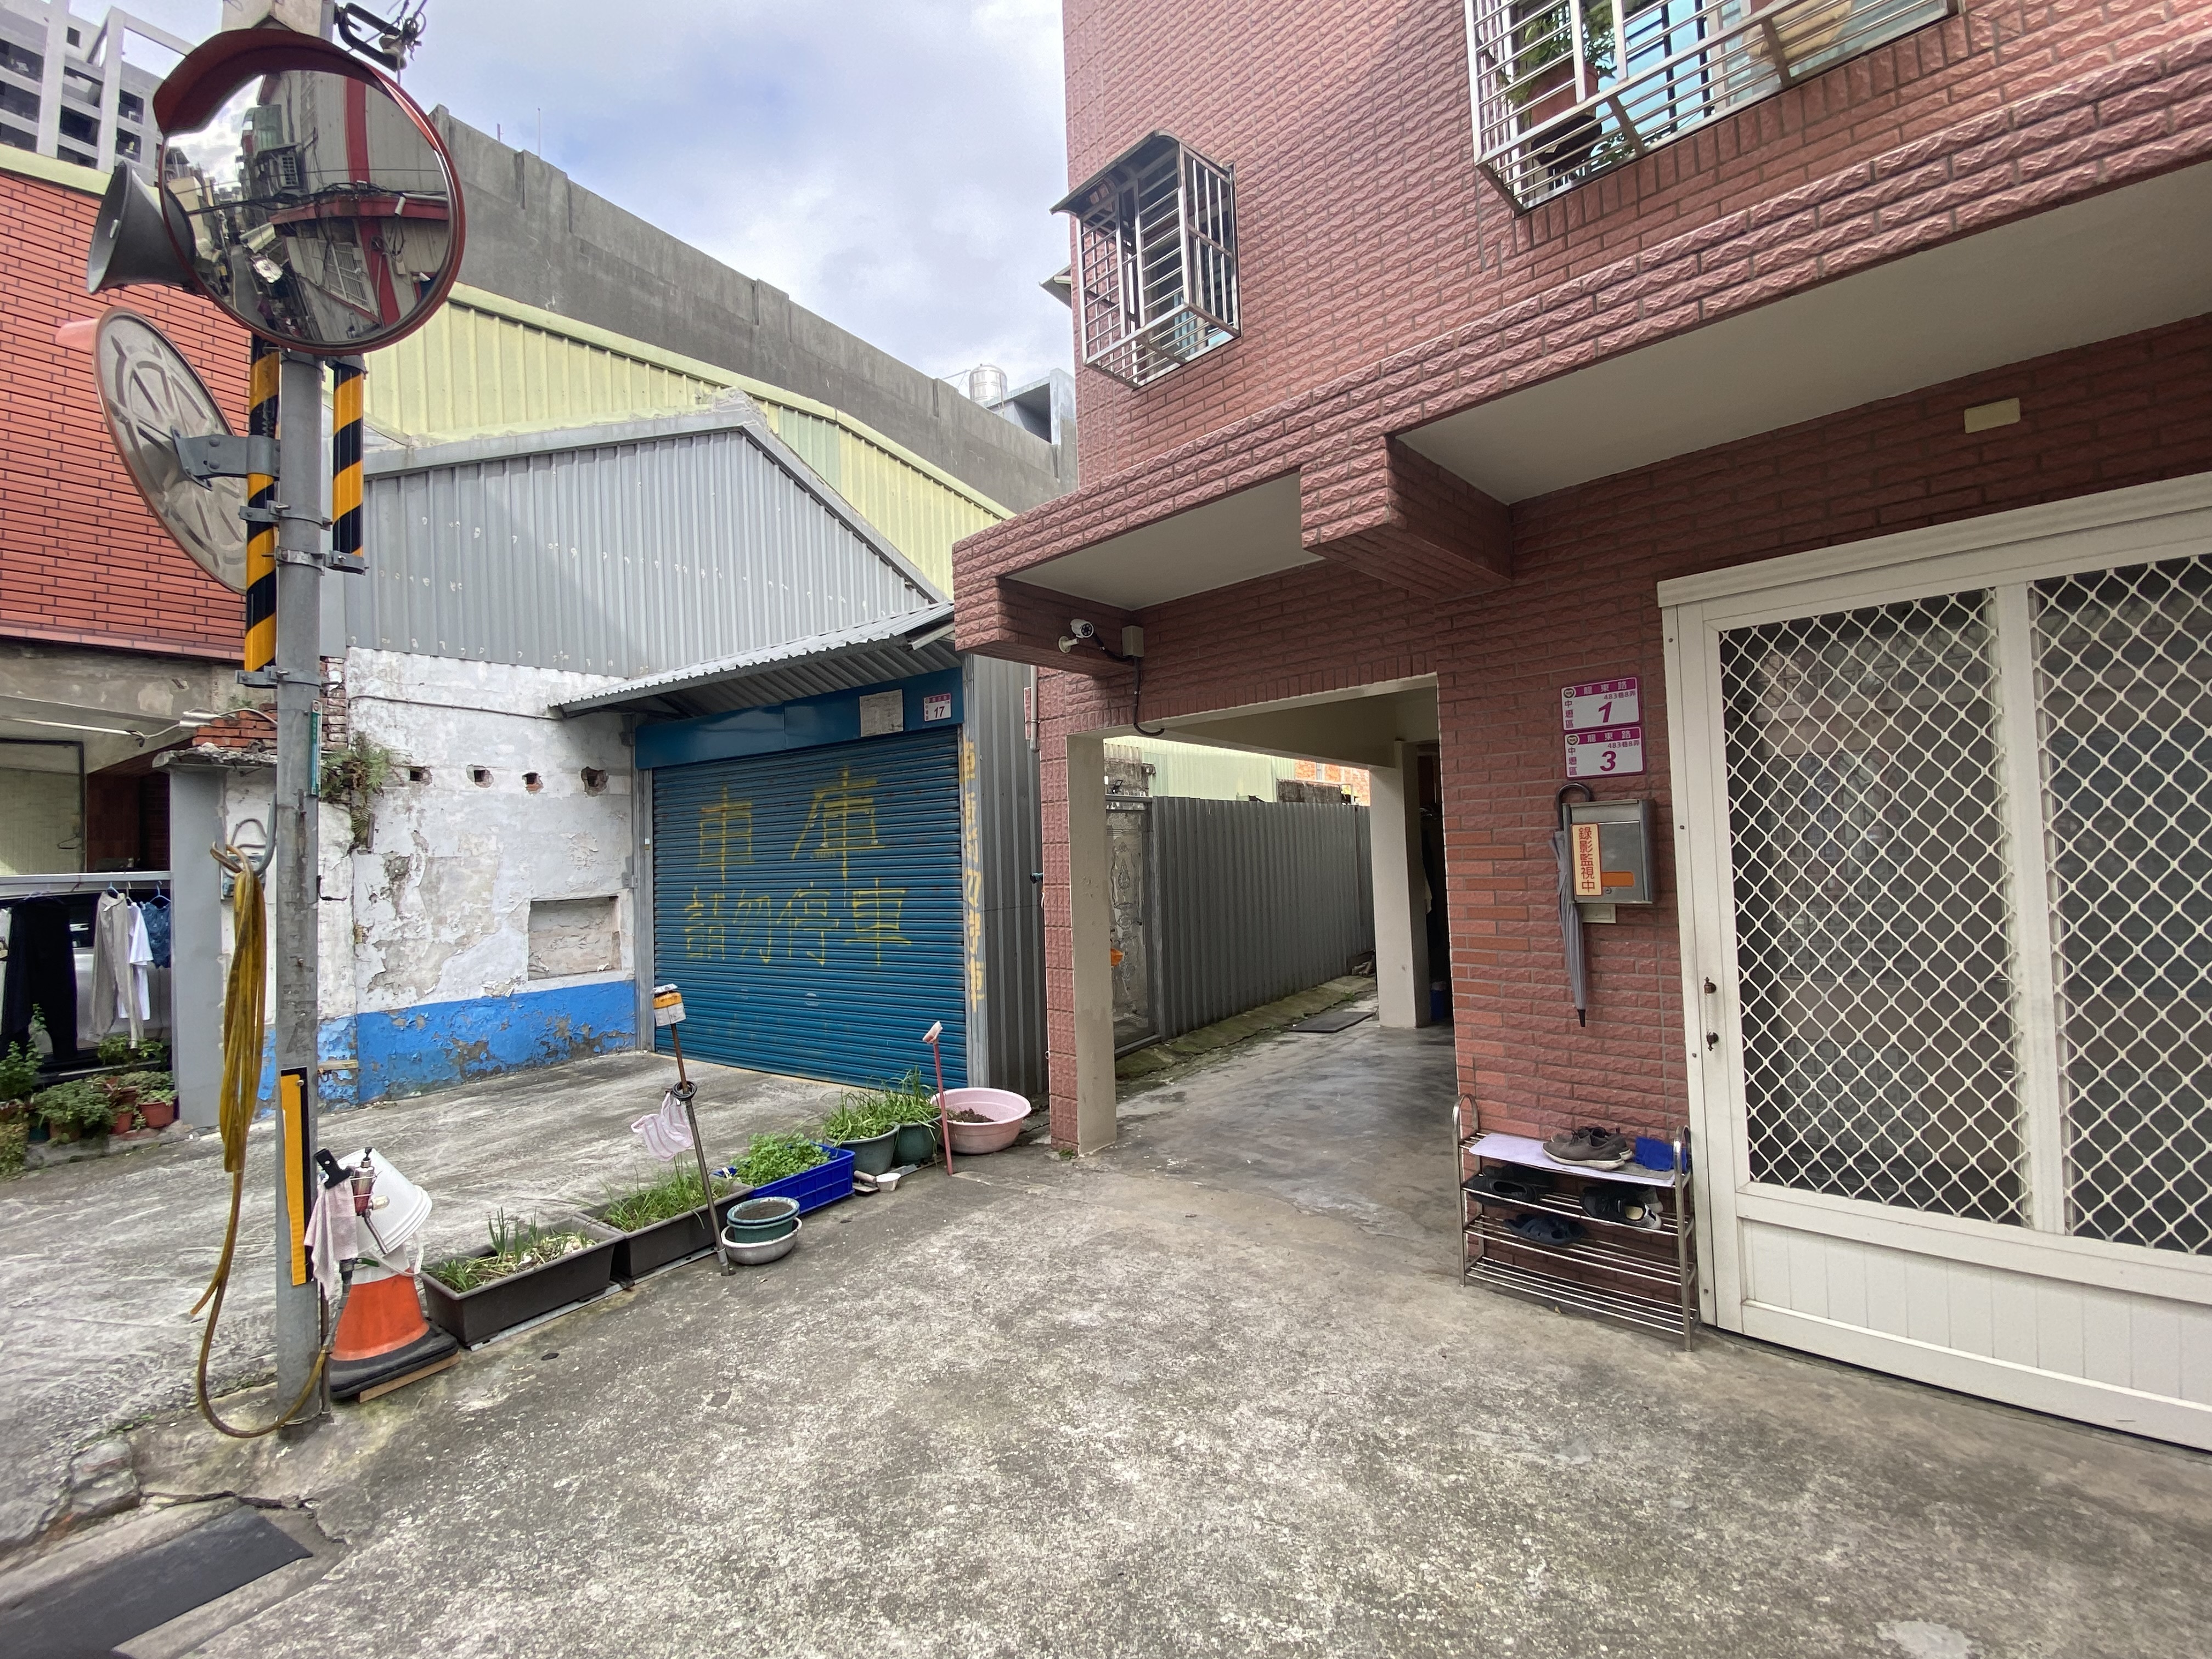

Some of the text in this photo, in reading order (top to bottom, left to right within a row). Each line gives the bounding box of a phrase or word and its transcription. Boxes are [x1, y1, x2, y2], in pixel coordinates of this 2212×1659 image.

[934, 706, 945, 718] 17
[1598, 701, 1612, 723] 1
[1600, 751, 1616, 771] 3
[1578, 827, 1595, 893] 錄影監視中
[685, 878, 912, 968] 請勿停車
